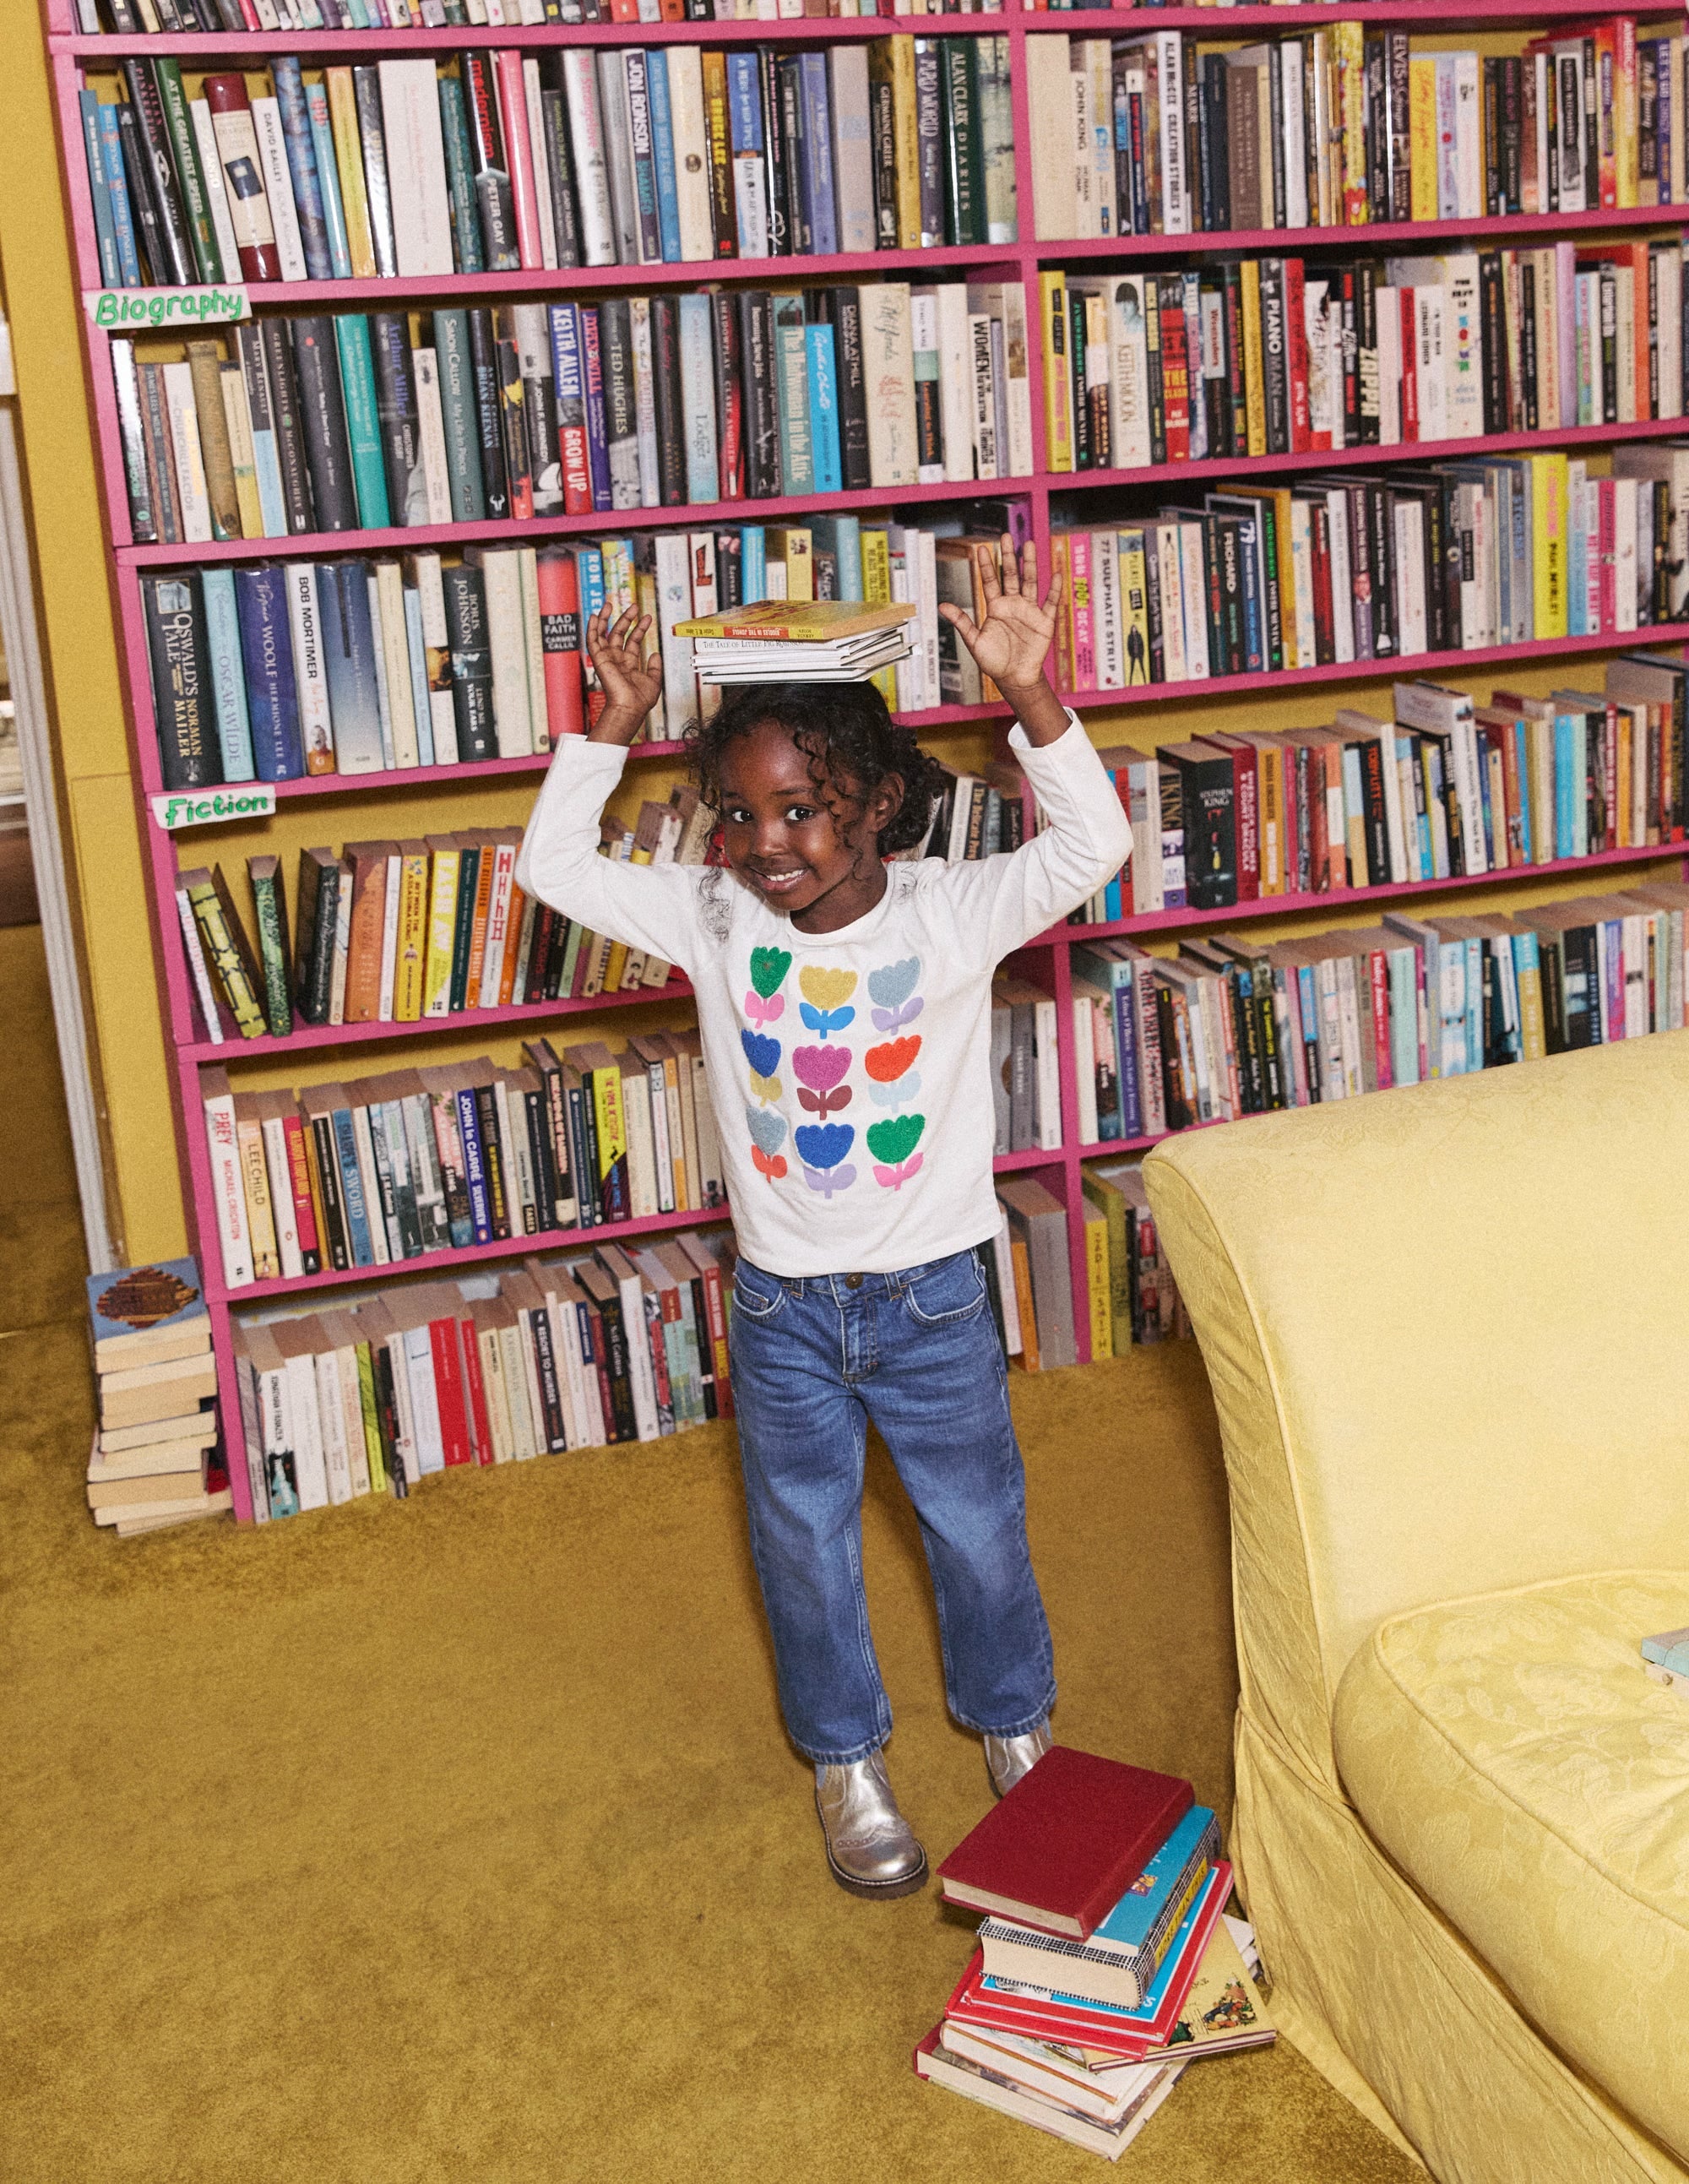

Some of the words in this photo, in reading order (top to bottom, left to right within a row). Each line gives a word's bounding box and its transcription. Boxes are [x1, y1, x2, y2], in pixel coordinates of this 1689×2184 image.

[951, 52, 967, 84] ALAN
[1165, 41, 1176, 69] ALAN
[169, 79, 178, 91] AT
[627, 59, 643, 92] JON
[173, 93, 183, 117] THE
[472, 59, 496, 159] modernism
[919, 94, 940, 138] WORLD
[953, 86, 969, 126] CLARK
[1074, 79, 1086, 113] JOHN
[630, 93, 650, 154] RONSON
[711, 98, 725, 139] BRUCE
[1076, 117, 1087, 150] KING
[177, 118, 193, 175] GREATEST
[263, 113, 275, 144] DAVID
[270, 149, 282, 182] BAILEY
[713, 142, 726, 165] LEE
[957, 132, 970, 210] DIARIES
[189, 179, 203, 214] SPEED
[486, 177, 501, 218] PETER
[492, 220, 505, 245] GAY
[96, 289, 242, 325] Biography
[847, 305, 858, 345] DIANA
[1267, 299, 1282, 354] PIANO
[388, 323, 405, 369] Arthur
[445, 318, 459, 352] SIMON
[551, 307, 577, 351] KEITH
[784, 329, 800, 350] The
[974, 322, 990, 373] WOMEN
[272, 332, 290, 413] GREENLIGHTS
[448, 354, 463, 396] CALLOW
[557, 354, 579, 396] ALLEN
[611, 343, 623, 373] TED
[850, 346, 860, 388] ATHILL
[1268, 356, 1282, 396] MAN
[394, 374, 409, 418] Miller
[476, 366, 491, 400] BRIAN
[785, 352, 806, 419] Madwoman
[1359, 347, 1379, 417] ZAPPA
[614, 376, 627, 433] HUGHES
[481, 404, 494, 448] KEENAN
[538, 421, 549, 463] KENNEDY
[693, 414, 708, 459] Lodger
[789, 421, 809, 432] in
[790, 434, 809, 450] the
[173, 408, 188, 465] CHURCHILL
[181, 469, 193, 511] FACTOR
[564, 429, 584, 469] GROW
[790, 453, 811, 481] Attic
[568, 472, 587, 492] UP
[1101, 540, 1111, 553] 77
[587, 554, 601, 584] RON
[256, 580, 274, 622] Virginia
[298, 577, 310, 603] BOB
[1102, 559, 1113, 627] SULPHATE
[453, 578, 472, 644] JOHNSON
[468, 593, 481, 631] BORIS
[545, 625, 577, 633] FAITH
[548, 616, 572, 625] BAD
[162, 622, 182, 663] TALE
[174, 613, 199, 697] OSWALD'S
[261, 625, 278, 677] WOOLF
[301, 607, 318, 679] MORTIMER
[1105, 632, 1116, 672] STRIP
[218, 655, 235, 708] OSCAR
[466, 683, 475, 707] YOUR
[174, 699, 191, 758] MAILER
[187, 698, 203, 756] NORMAN
[269, 682, 282, 736] HERMIONE
[469, 709, 478, 732] EARS
[223, 712, 241, 764] WILDE
[274, 741, 284, 759] LEE
[166, 794, 268, 827] Fiction
[1161, 784, 1181, 829] KING
[1240, 784, 1249, 820] COUNT
[1241, 823, 1251, 872] DRACULA
[434, 859, 456, 915] TASH
[433, 919, 451, 953] AW
[215, 1112, 232, 1145] PREY
[459, 1095, 475, 1127] JOHN
[247, 1143, 260, 1165] LEE
[465, 1128, 476, 1140] le
[223, 1159, 237, 1198] MICHAEL
[444, 1169, 457, 1193] SING
[467, 1141, 483, 1182] CARRÉ
[251, 1168, 265, 1206] CHILD
[344, 1168, 364, 1220] SWORD
[226, 1199, 241, 1241] CRICHTON
[524, 1207, 535, 1231] FABER
[537, 1325, 549, 1355] RESORT
[540, 1358, 550, 1369] TO
